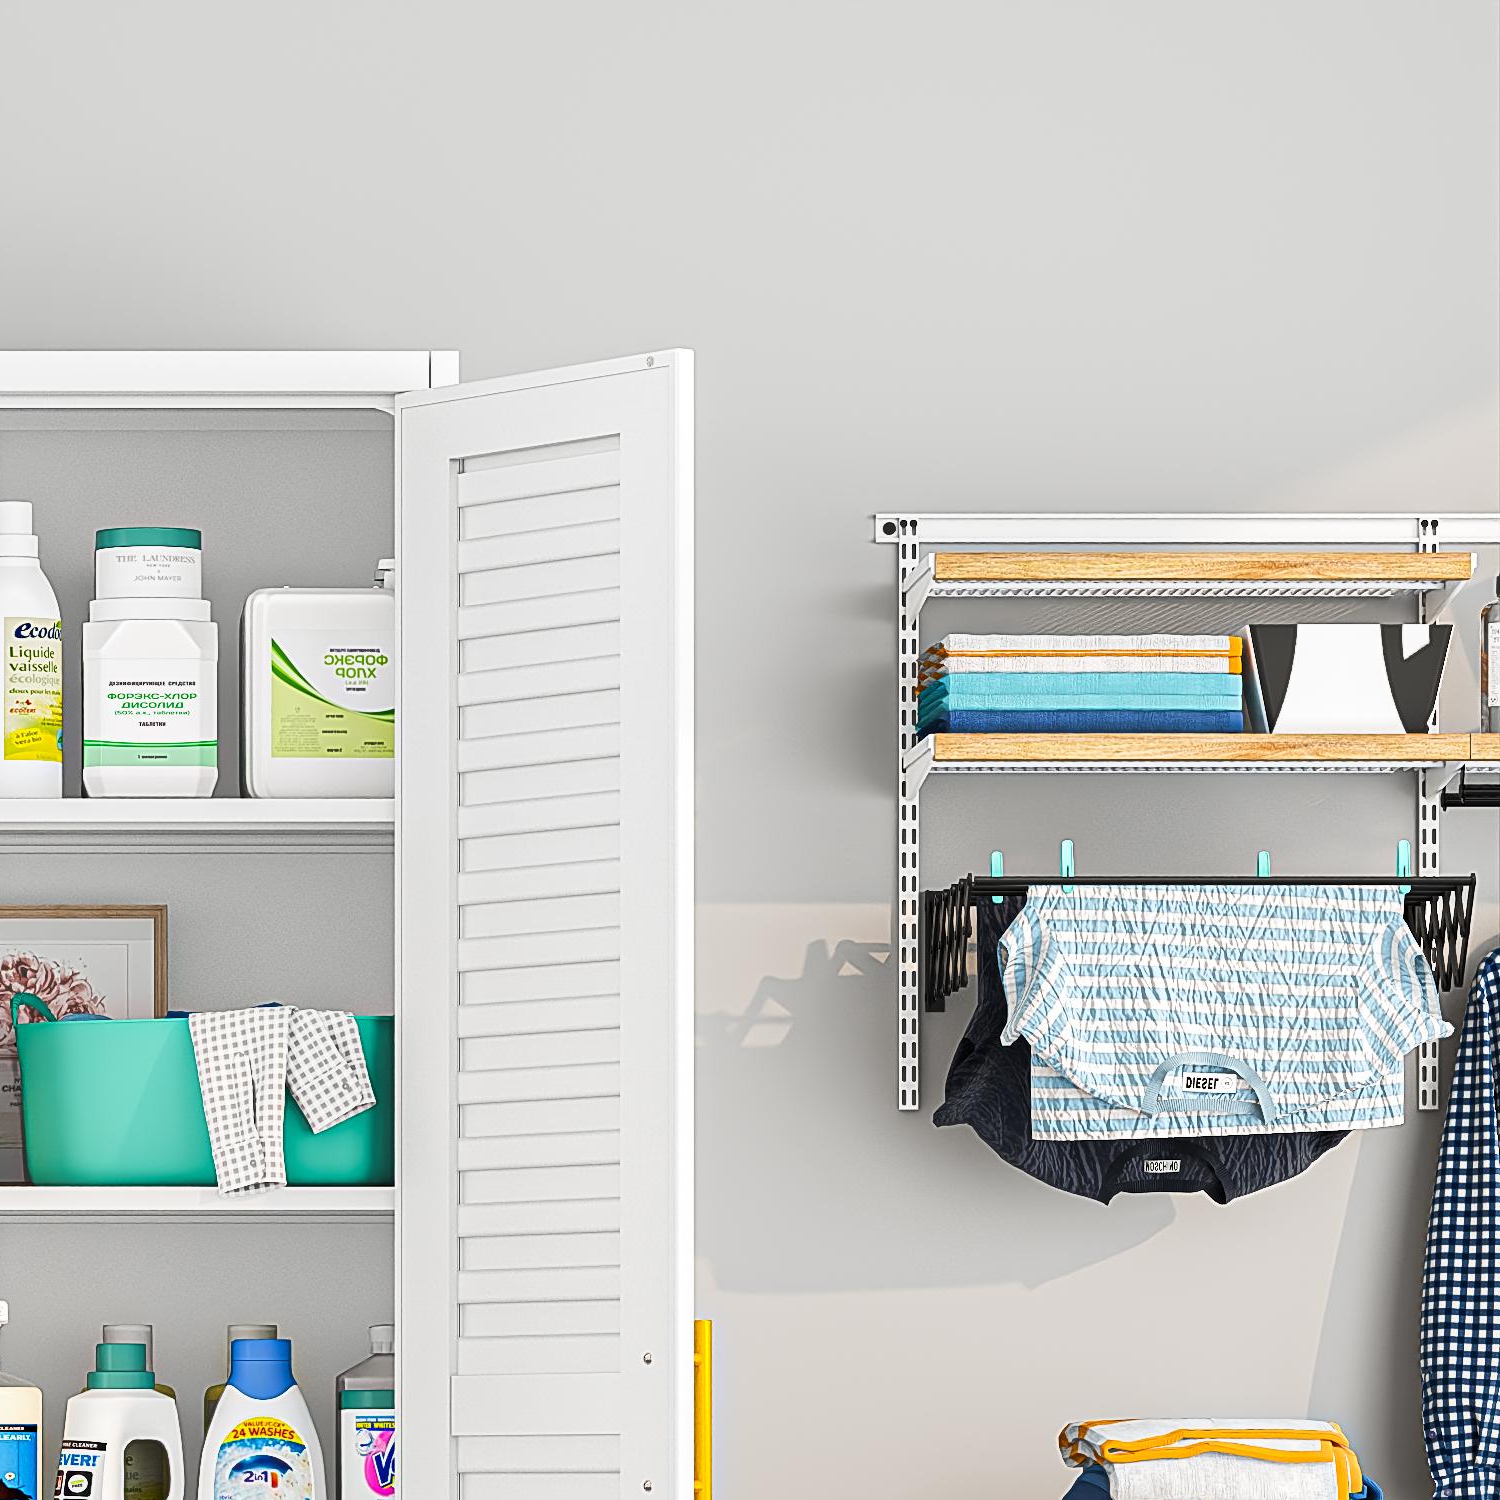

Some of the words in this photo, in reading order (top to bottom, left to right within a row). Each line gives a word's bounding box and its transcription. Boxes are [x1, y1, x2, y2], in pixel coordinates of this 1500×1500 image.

[116, 555, 137, 563] THE
[142, 555, 195, 564] LAUNDRESS
[9, 645, 55, 661] Liquide
[9, 661, 58, 673] vaisselle
[9, 673, 60, 687] écologique
[107, 692, 197, 701] ФОРЭКС-ХЛОР
[121, 701, 184, 709] ДИСОЛИД
[232, 1430, 246, 1439] 24
[249, 1427, 295, 1440] WASHES
[243, 1470, 269, 1483] 2in1
